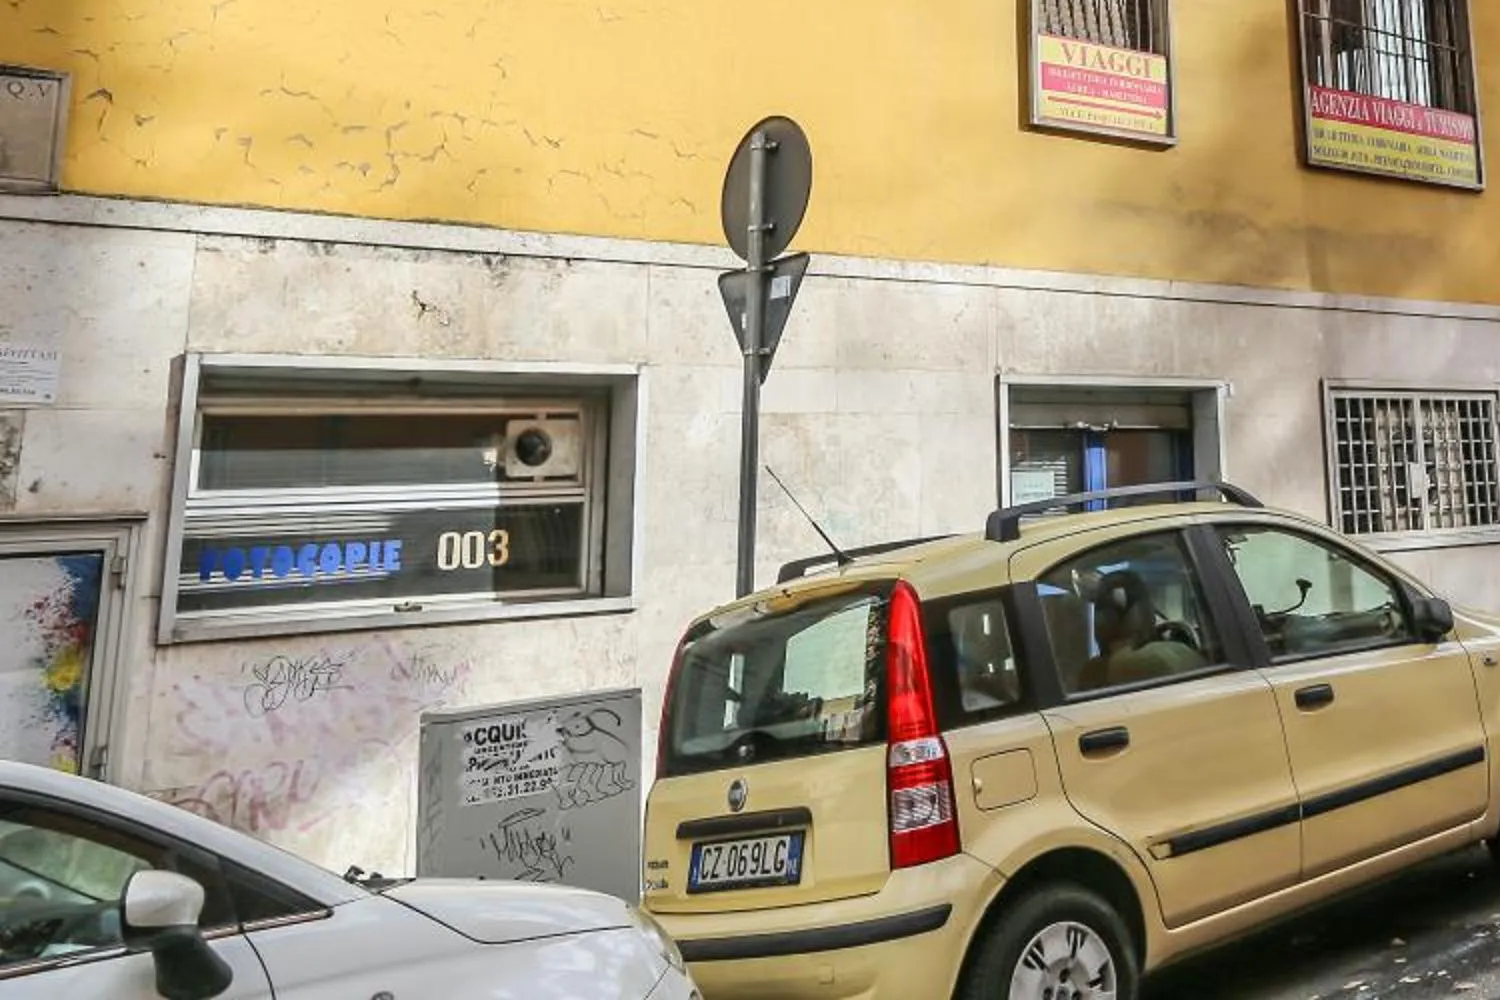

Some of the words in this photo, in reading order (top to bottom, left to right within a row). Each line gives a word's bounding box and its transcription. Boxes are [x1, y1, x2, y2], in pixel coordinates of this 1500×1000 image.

[1061, 42, 1151, 78] VIAGGI
[1311, 90, 1370, 122] AGENZIA
[200, 539, 403, 581] FOTOCOPIE
[437, 529, 509, 571] 003
